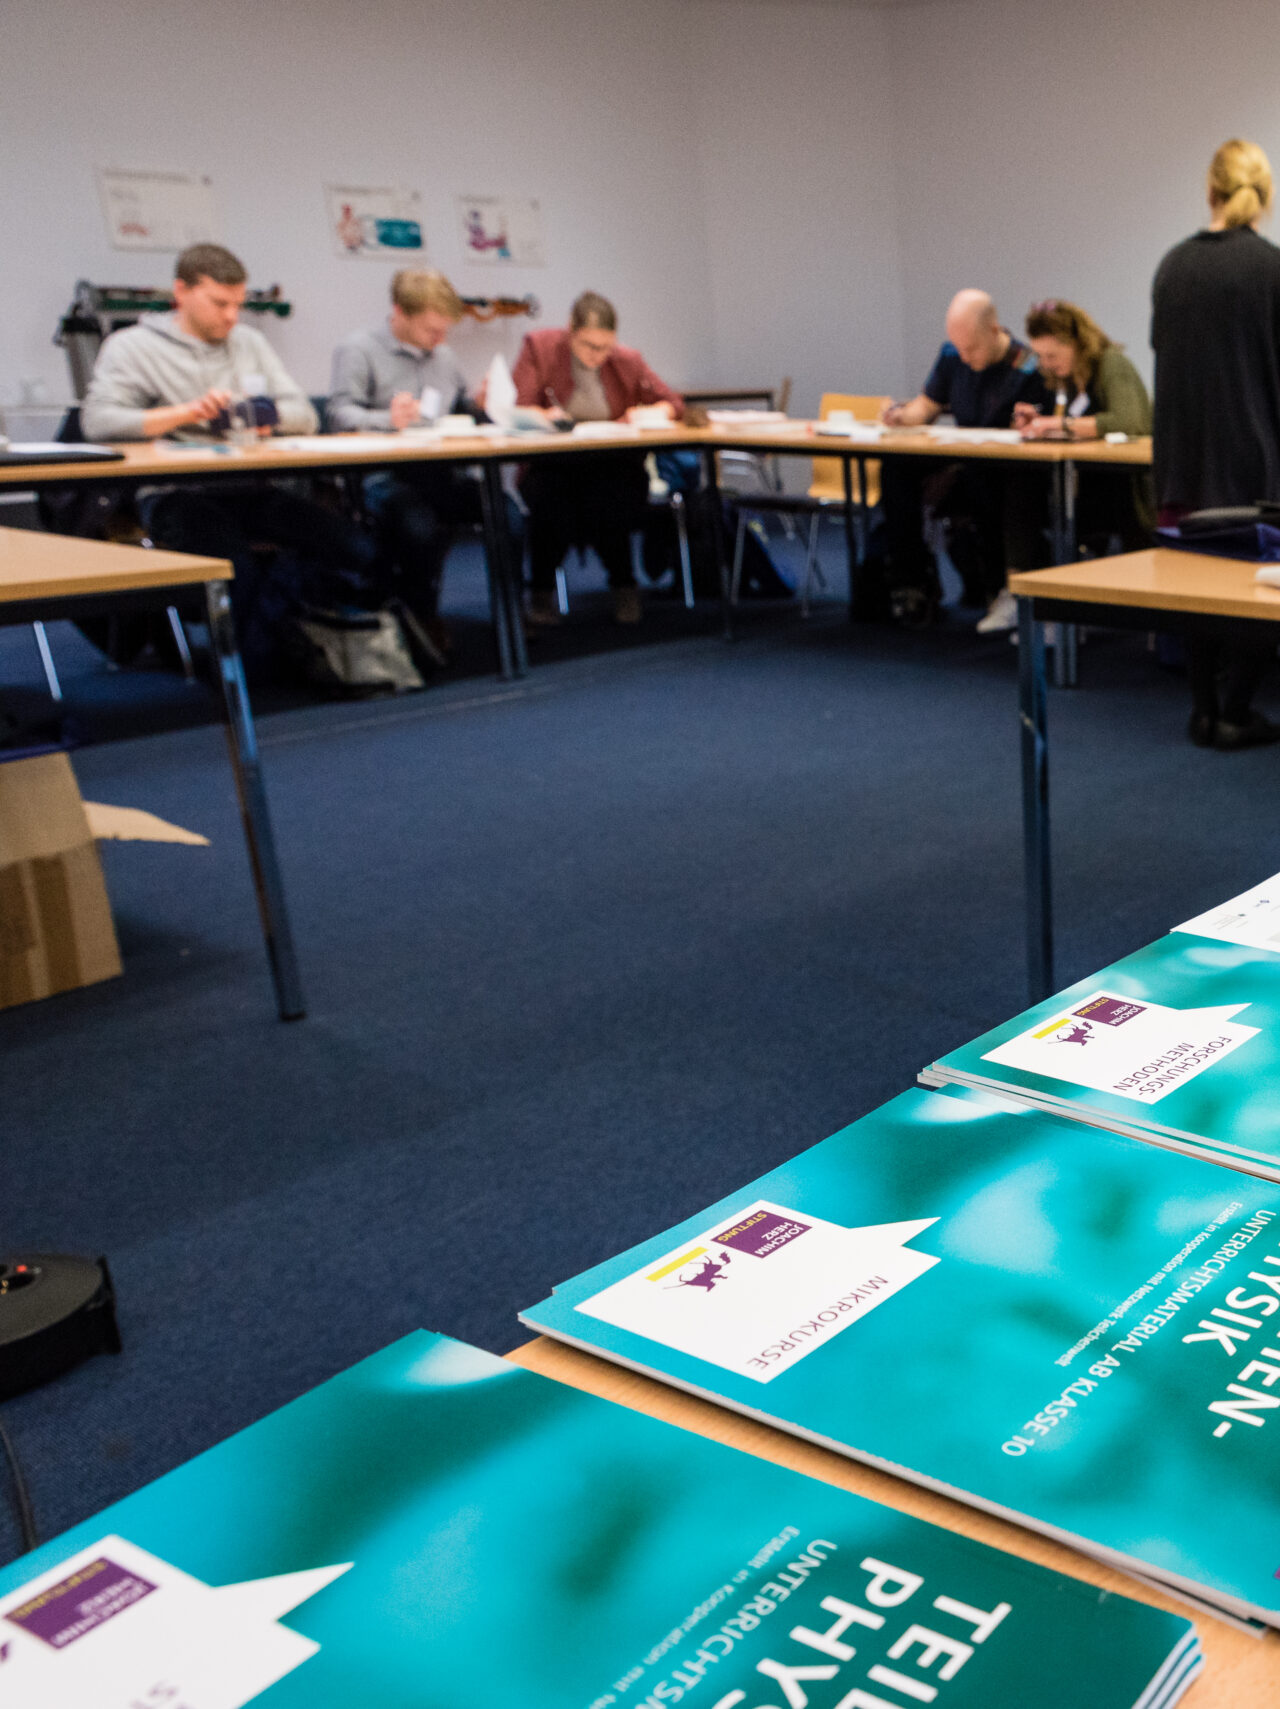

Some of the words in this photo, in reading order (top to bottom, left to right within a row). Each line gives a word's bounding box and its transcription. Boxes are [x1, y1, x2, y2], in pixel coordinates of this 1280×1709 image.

[1109, 1004, 1142, 1026] JOACHIM
[1111, 1003, 1132, 1016] HERZ
[1113, 1042, 1195, 1091] METHODEN
[1138, 1036, 1233, 1096] FORSCHUNGS-
[717, 1212, 768, 1242] STIFTUNG
[1212, 1201, 1243, 1225] Erstellt
[754, 1223, 805, 1255] JOACHIM
[761, 1221, 793, 1241] HERZ
[1162, 1231, 1210, 1273] Kooperation
[1111, 1209, 1277, 1353] UNTERRICHTSMATERIAL
[1109, 1283, 1155, 1320] Netzwerk
[745, 1274, 889, 1370] MIKROKURSE
[1054, 1317, 1117, 1367] Teilchenwelt
[1088, 1353, 1121, 1378] AB
[1024, 1377, 1099, 1437] KLASSE
[1001, 1435, 1035, 1457] 10
